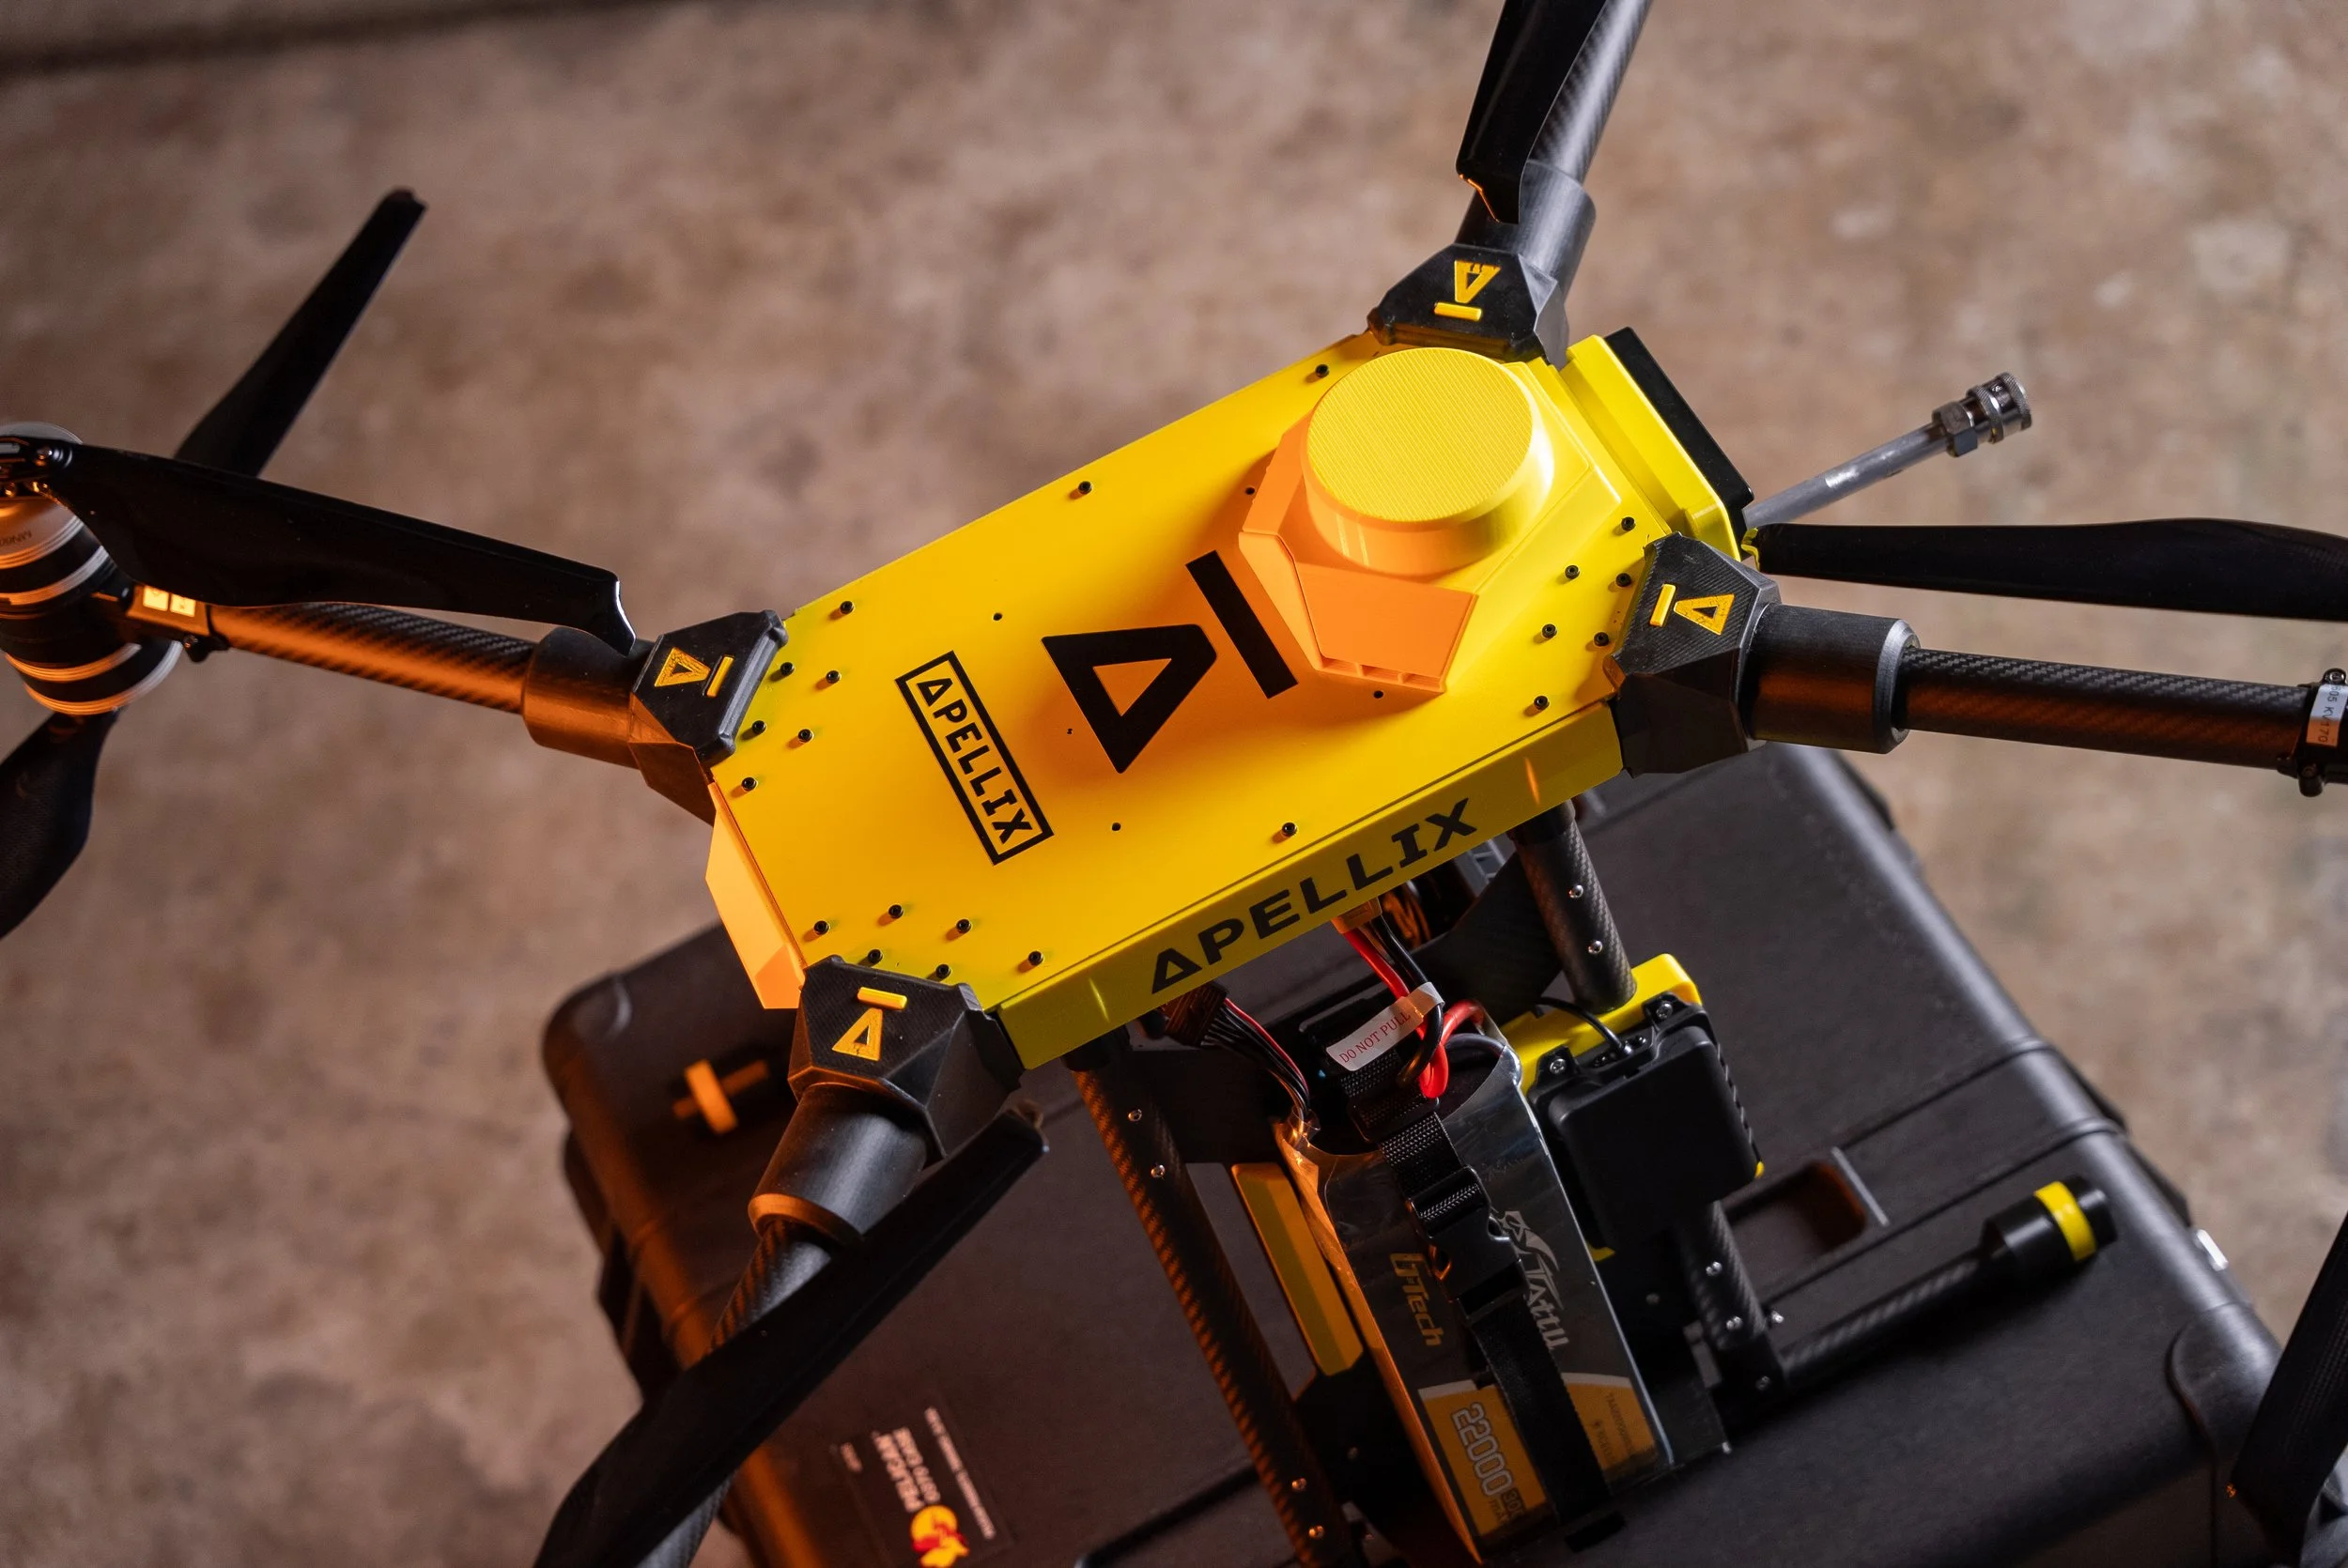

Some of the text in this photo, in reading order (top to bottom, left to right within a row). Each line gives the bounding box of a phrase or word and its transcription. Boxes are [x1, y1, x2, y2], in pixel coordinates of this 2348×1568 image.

[917, 677, 1032, 844] APELLIX
[2318, 706, 2334, 743] KV170
[1151, 798, 1476, 993] APELLIX
[1338, 1012, 1411, 1063] DO NOT PULL
[1451, 1402, 1513, 1496] 22000
